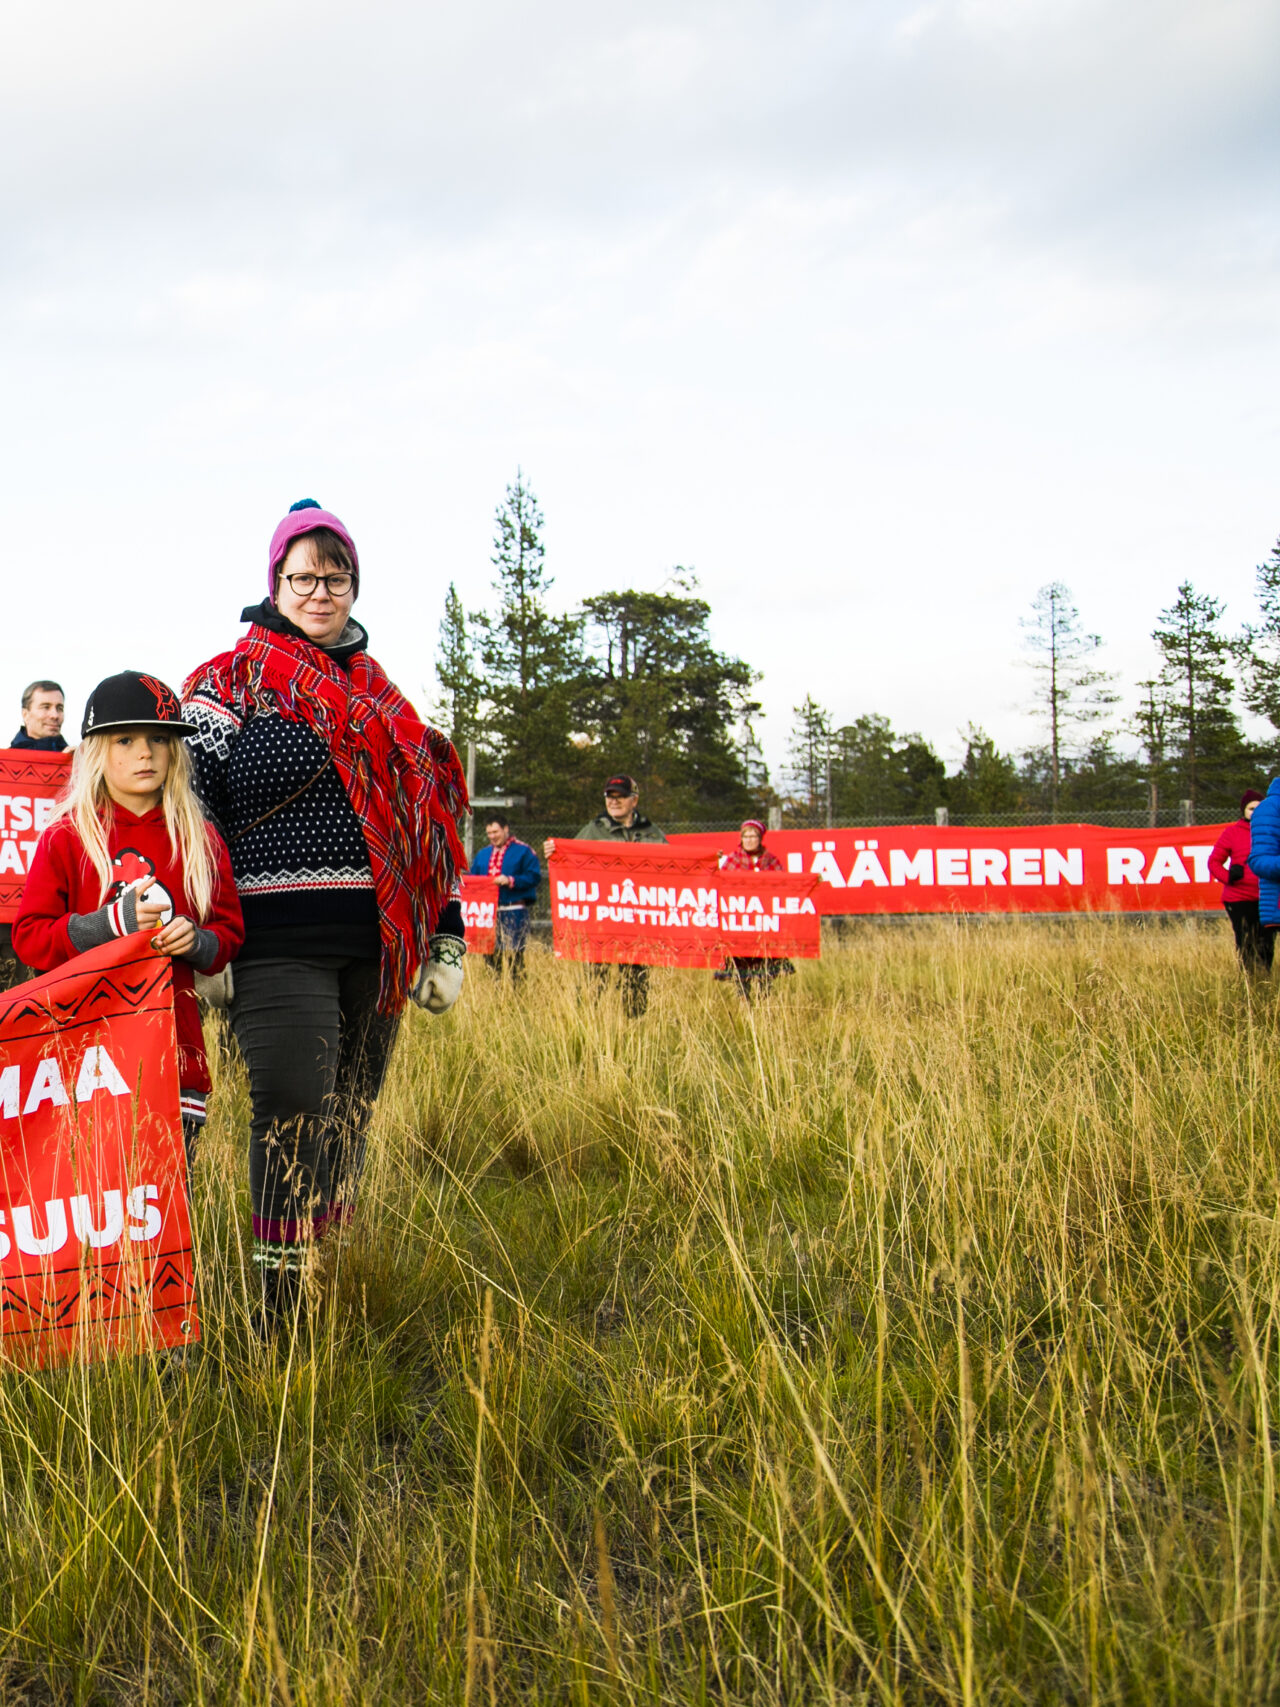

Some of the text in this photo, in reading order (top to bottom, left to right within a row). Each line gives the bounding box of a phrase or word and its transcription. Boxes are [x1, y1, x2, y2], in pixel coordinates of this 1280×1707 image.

[1106, 845, 1220, 885] RAT
[556, 878, 718, 908] MIJ JÂNNAM
[558, 903, 590, 921] MIJ
[772, 897, 816, 914] LEA
